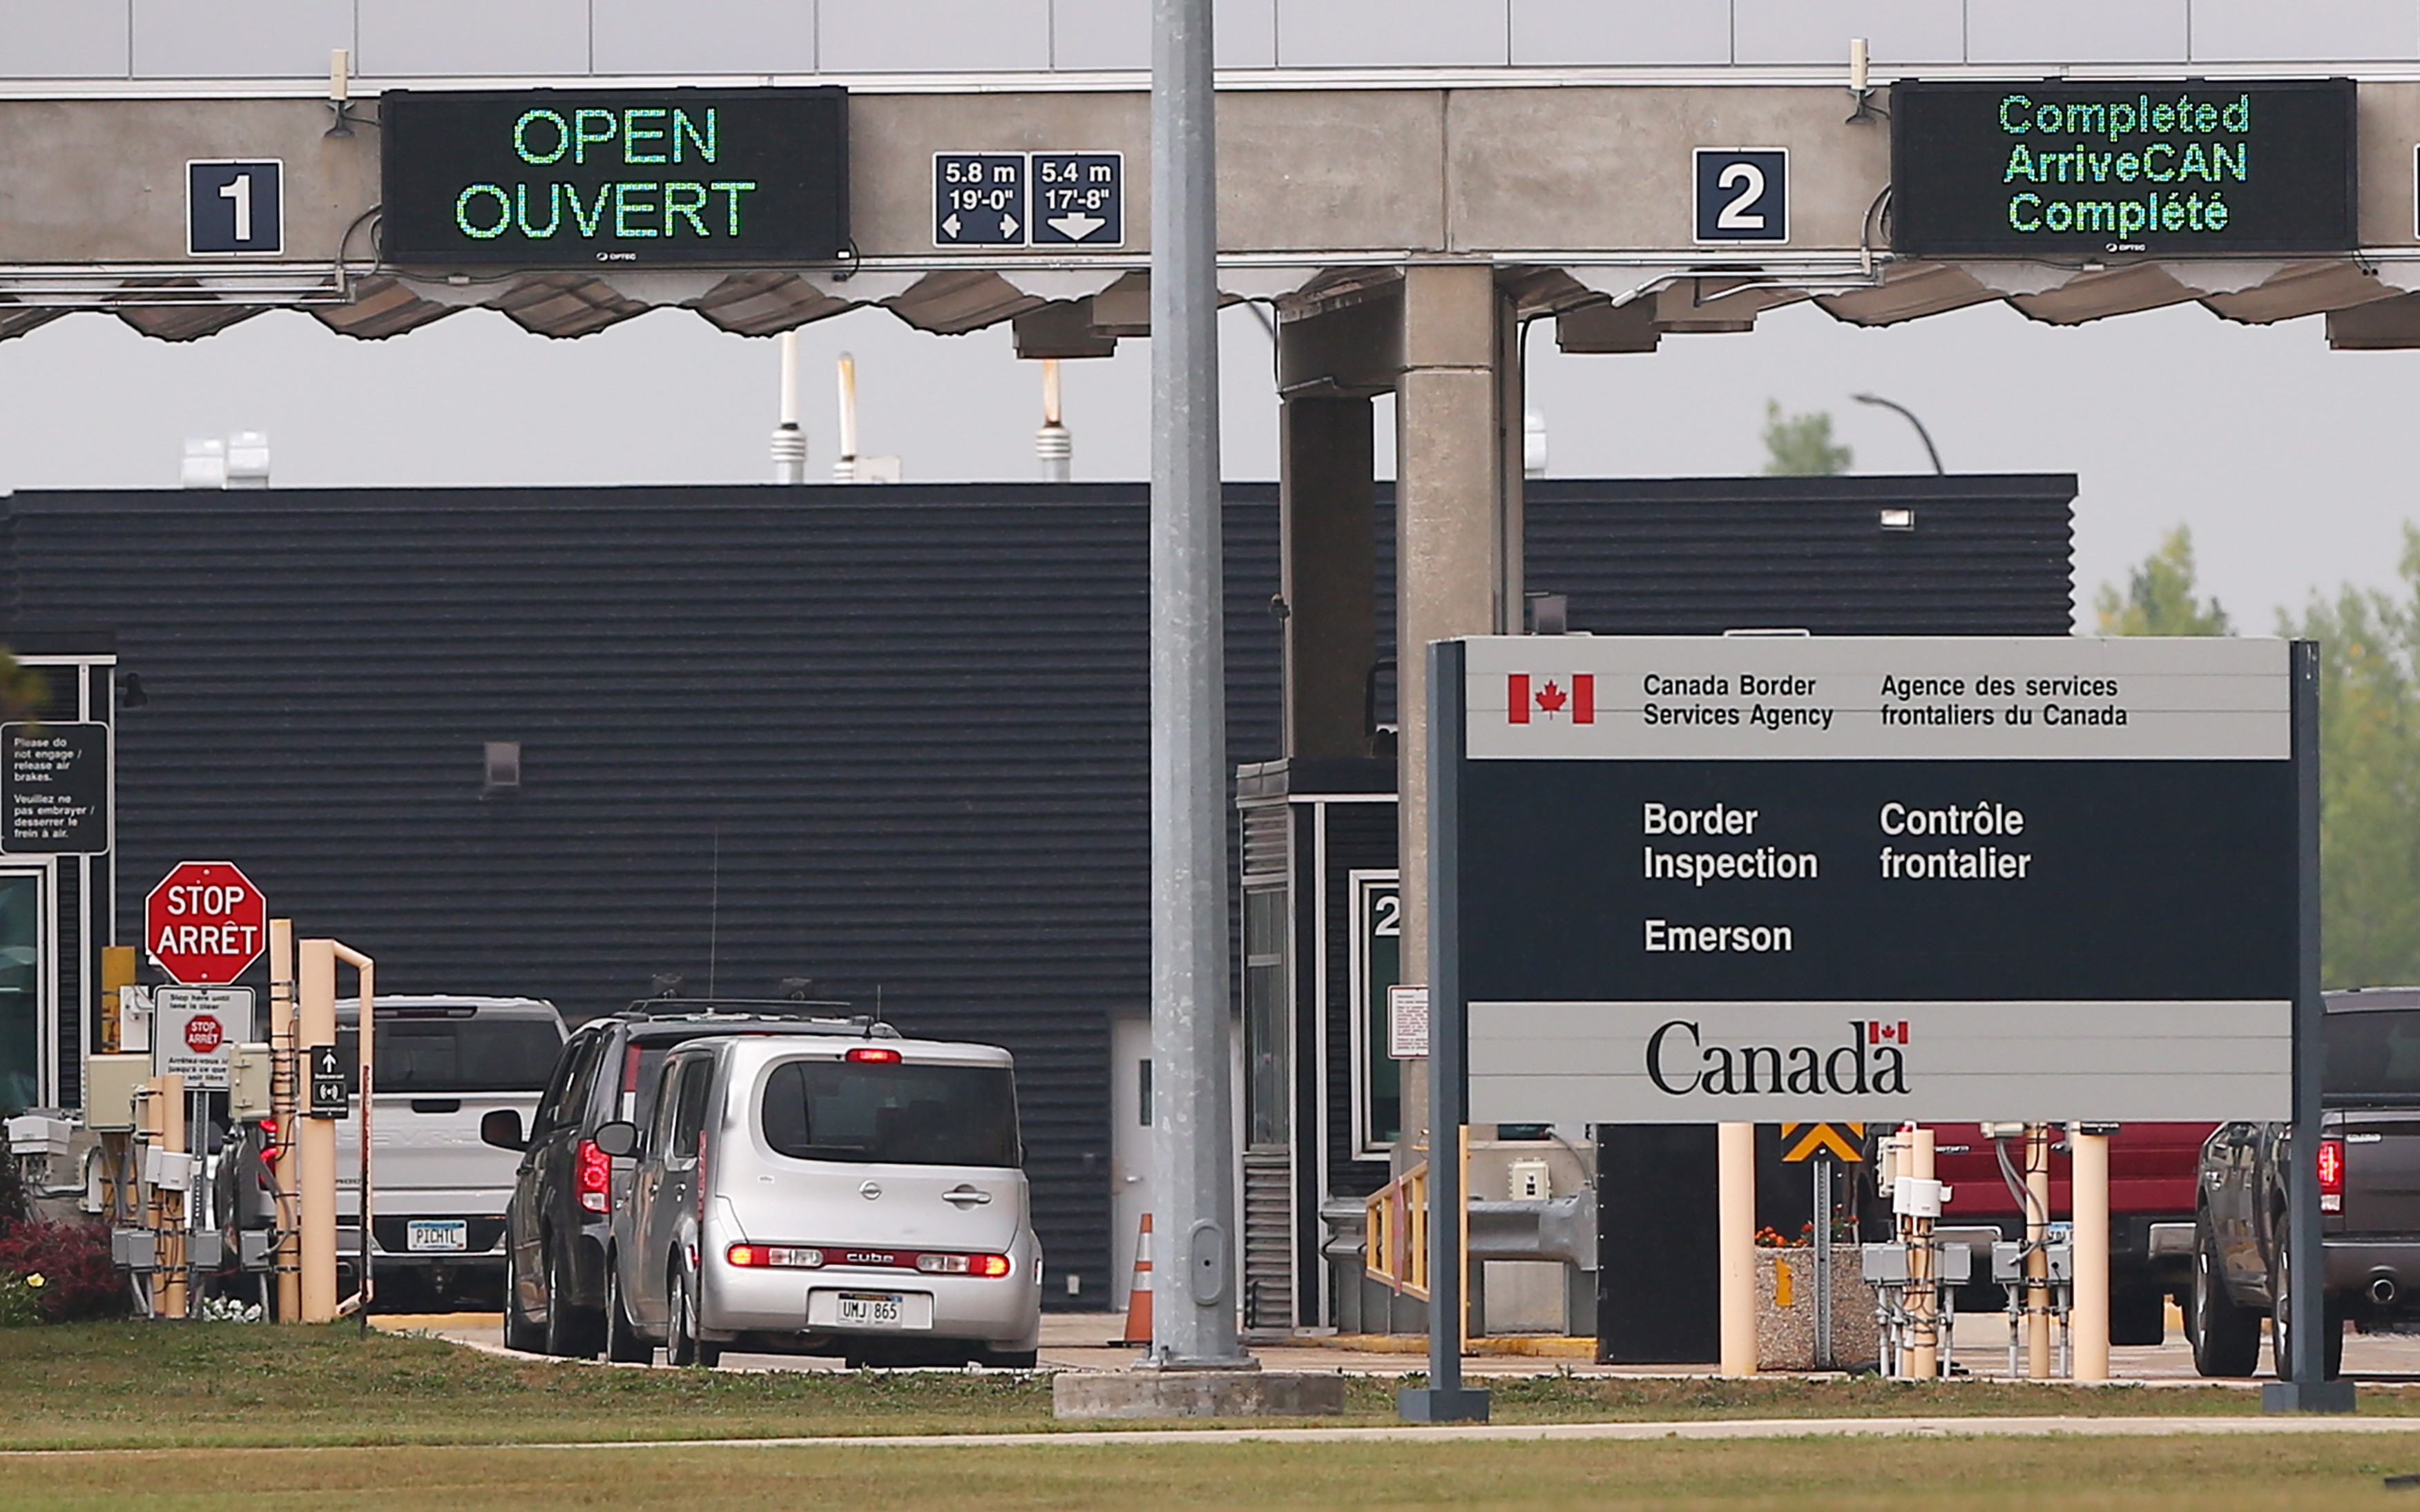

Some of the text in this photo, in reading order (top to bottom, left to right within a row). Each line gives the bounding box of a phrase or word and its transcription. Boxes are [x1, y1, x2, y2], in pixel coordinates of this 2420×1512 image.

[2000, 95, 2247, 142] Completed
[515, 109, 715, 163] OPEN
[946, 163, 1015, 182] 5.8 m
[1042, 163, 1111, 182] 5.4 m
[2004, 144, 2245, 182] ArriveCAN
[220, 175, 249, 240] 1
[950, 190, 1012, 209] 19'-0"
[1046, 189, 1108, 209] 17'-8"
[1718, 164, 1763, 228] 2
[457, 183, 755, 238] OUVERT
[2010, 193, 2227, 239] Complété
[1644, 675, 1816, 695] Canada Border
[1881, 675, 2118, 701] Agence des services
[1644, 704, 1833, 730] Services Agency
[1881, 704, 2126, 725] frontaliers du Canada
[14, 737, 67, 747] Please do
[14, 750, 32, 758] not
[35, 751, 74, 760] engage
[14, 761, 70, 770] release air
[15, 773, 52, 782] brakes.
[14, 795, 54, 803] Veuillez
[15, 807, 33, 817] pas
[37, 806, 86, 816] embrayer
[14, 817, 78, 826] desserrer le
[1645, 804, 1758, 834] Border
[1881, 802, 2023, 834] Contrôle
[14, 829, 38, 837] frein
[1645, 847, 1816, 886] Inspection
[1881, 847, 2030, 878] frontalier
[167, 886, 244, 915] STOP
[1375, 895, 1400, 936] 2
[156, 920, 258, 955] ARRÊT
[1646, 920, 1791, 951] Emerson
[191, 1022, 216, 1032] STOP
[1646, 1021, 1910, 1094] Canada
[847, 1253, 894, 1263] cube
[843, 1301, 897, 1319] UMJ 865
